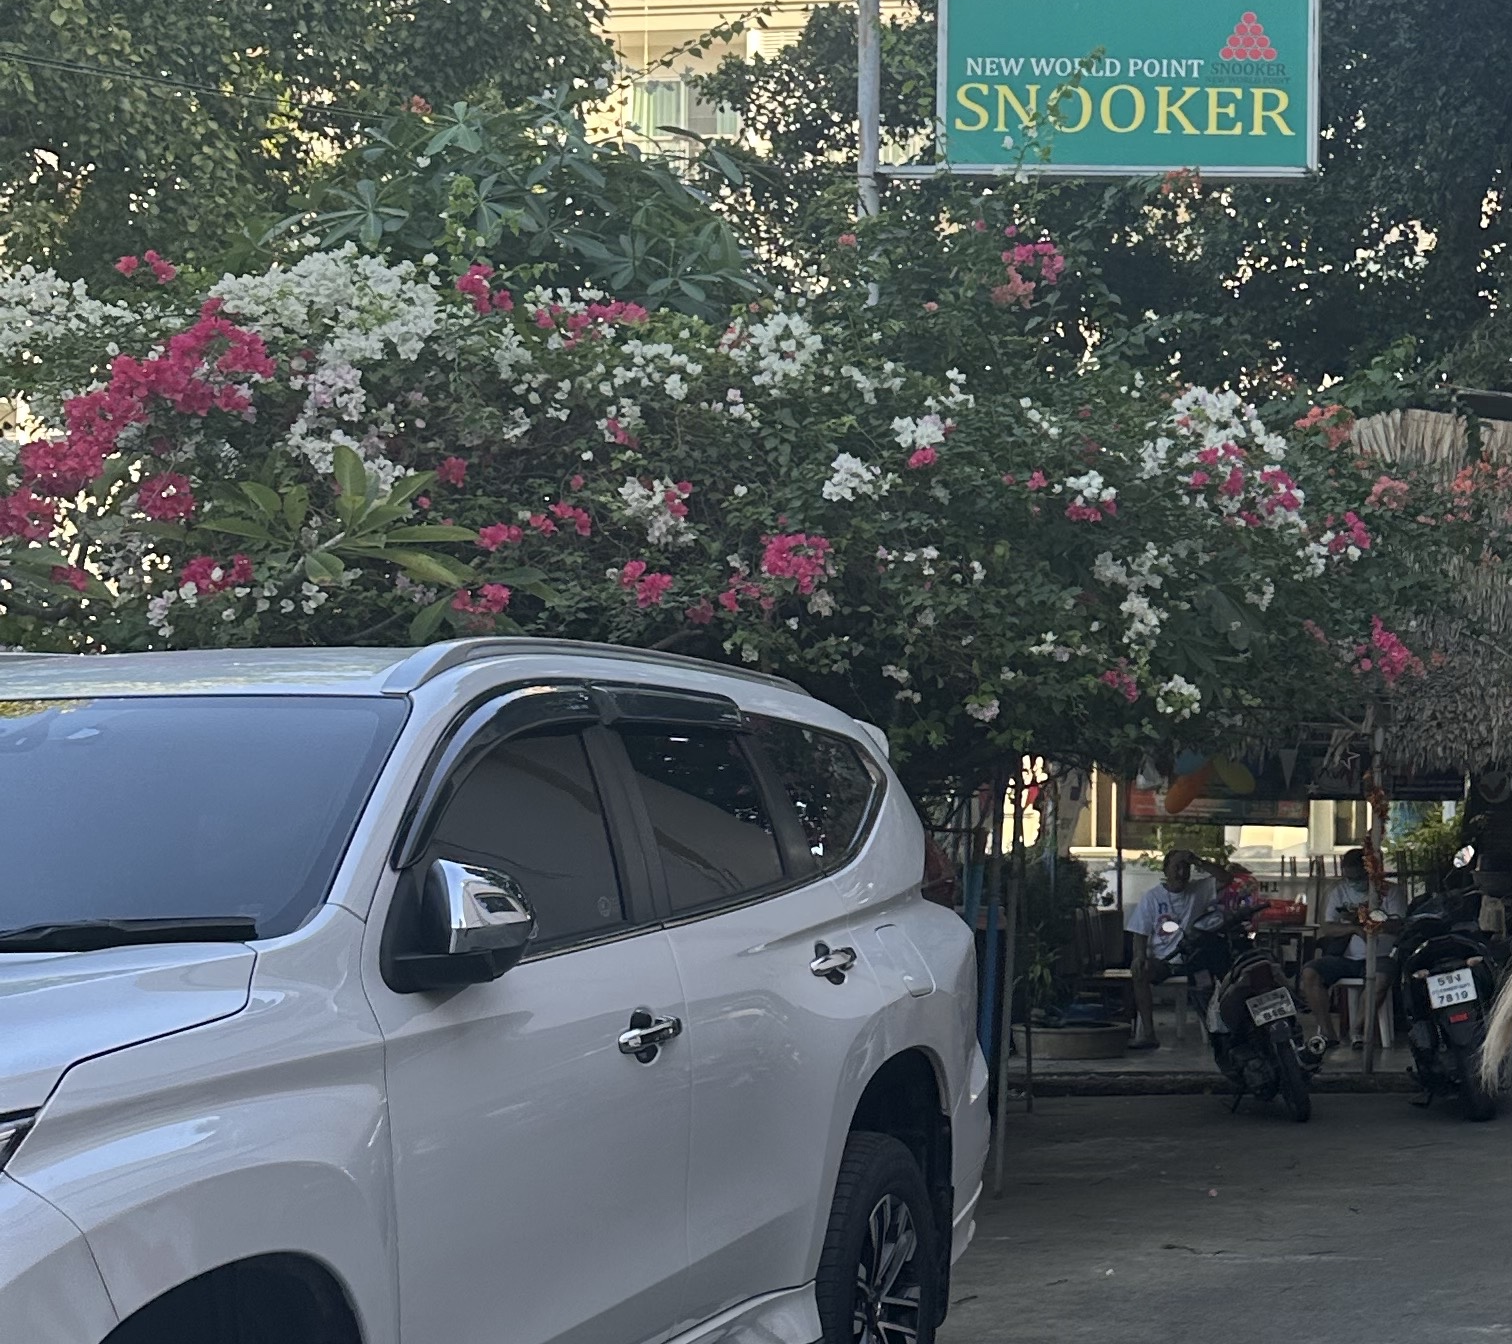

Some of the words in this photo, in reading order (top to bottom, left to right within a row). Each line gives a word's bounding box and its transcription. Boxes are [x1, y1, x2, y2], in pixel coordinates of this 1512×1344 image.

[966, 57, 1024, 76] NEW
[1128, 58, 1204, 78] POINT
[1210, 62, 1286, 77] SNOOKER
[955, 82, 1296, 136] SNOOKER
